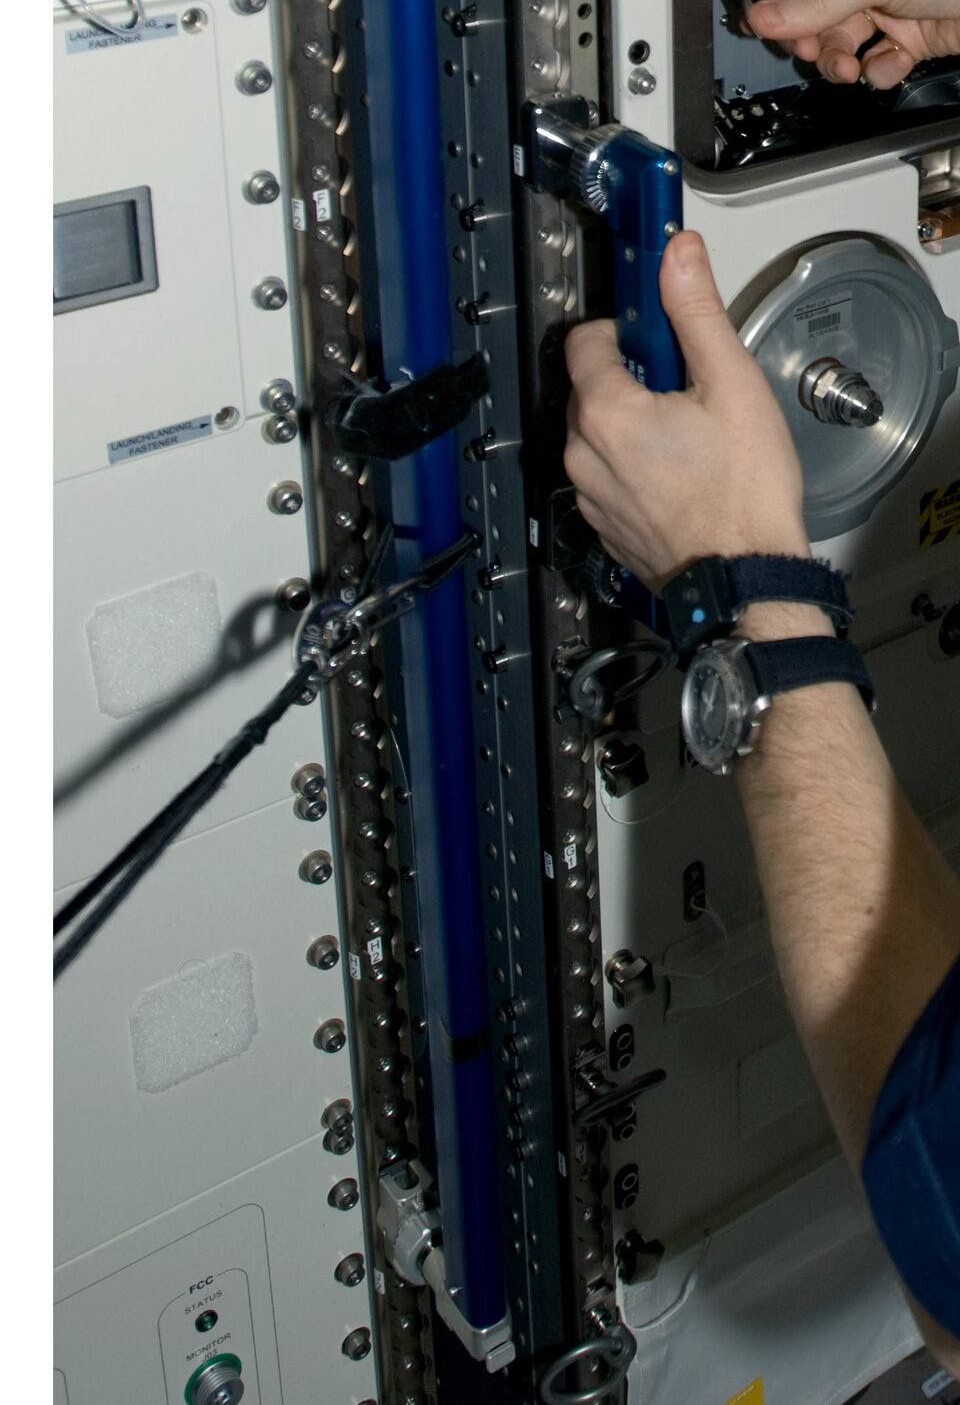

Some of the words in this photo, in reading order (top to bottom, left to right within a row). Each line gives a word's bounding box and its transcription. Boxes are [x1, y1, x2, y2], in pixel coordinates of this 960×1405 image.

[88, 34, 142, 50] FASTENER
[110, 421, 192, 451] LAUNCH/LANDING
[128, 436, 179, 457] FASTENER
[184, 1290, 223, 1315] STATUS
[185, 1332, 231, 1363] MONITOR
